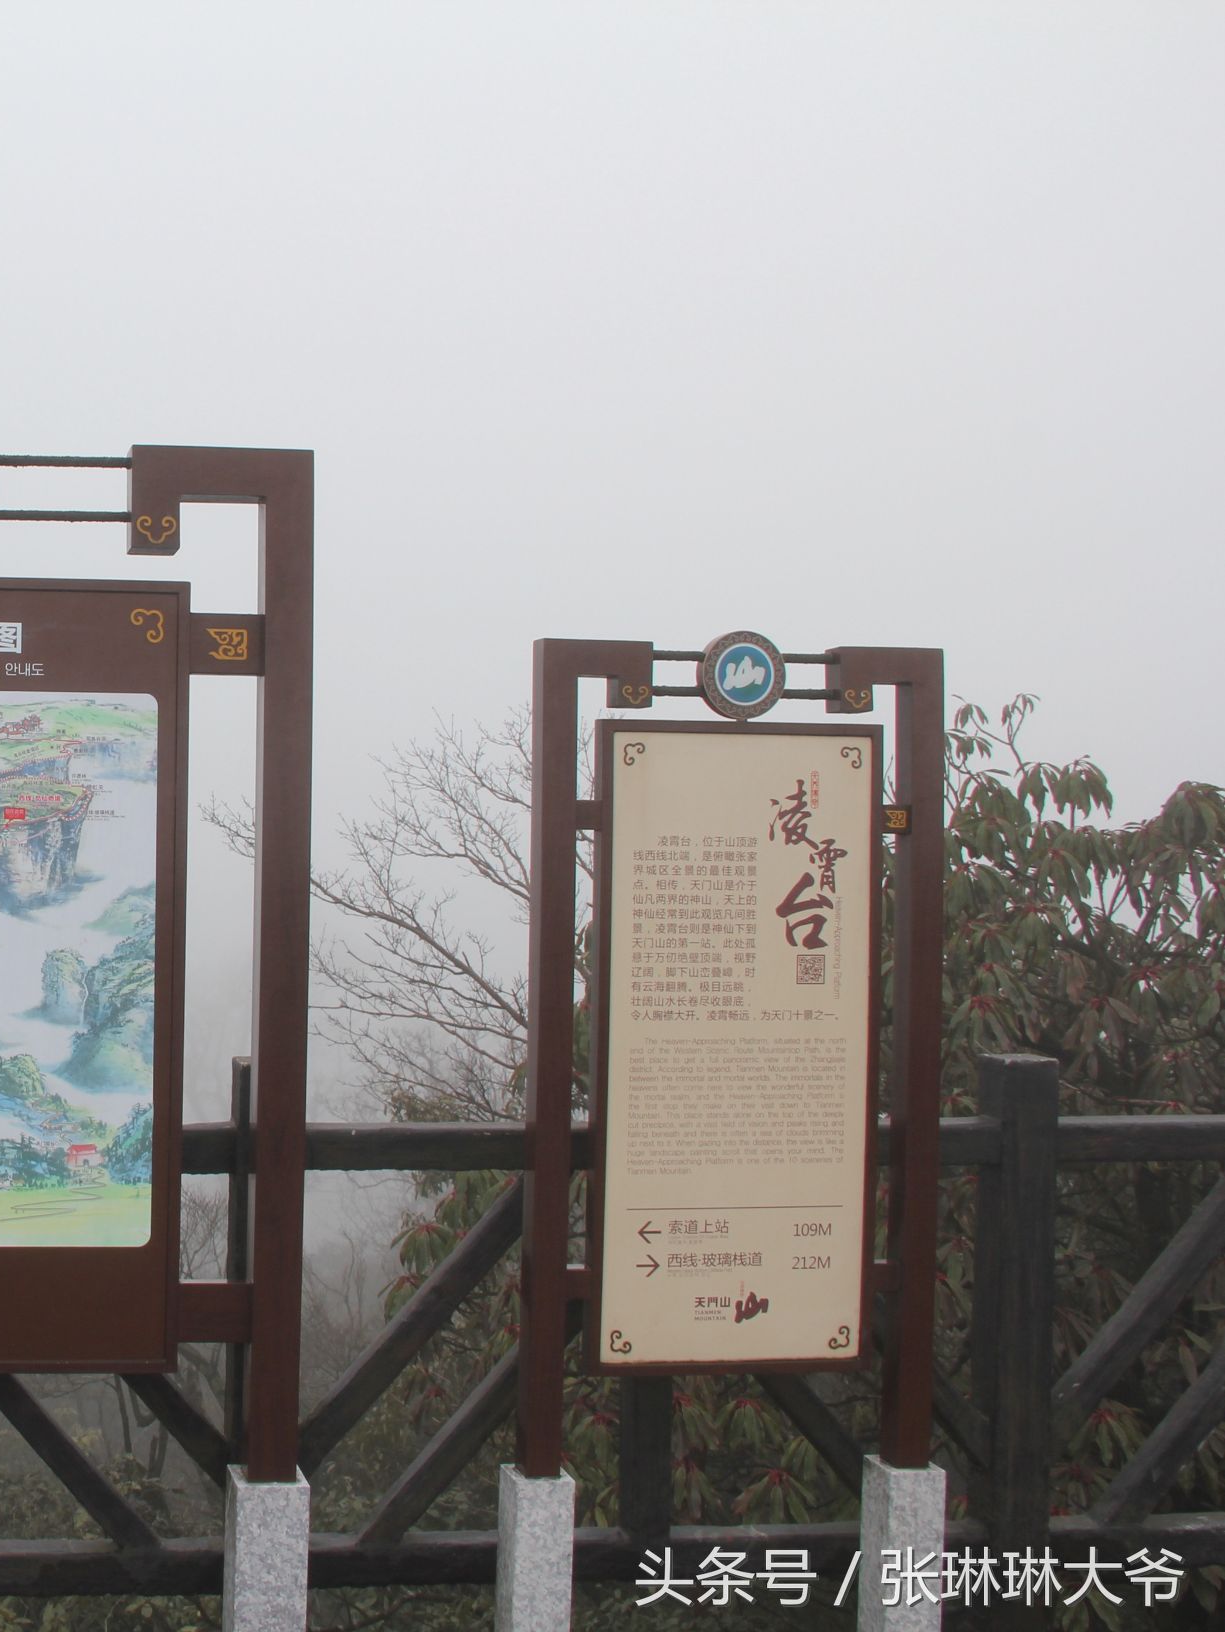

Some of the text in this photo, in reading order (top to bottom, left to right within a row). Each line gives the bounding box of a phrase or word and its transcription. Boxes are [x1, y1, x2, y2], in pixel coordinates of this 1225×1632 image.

[5, 662, 44, 676] 안내도
[668, 1219, 729, 1234] 索道上站
[793, 1223, 831, 1237] 109M
[792, 1256, 830, 1270] 212M
[694, 1297, 730, 1308] 天門山
